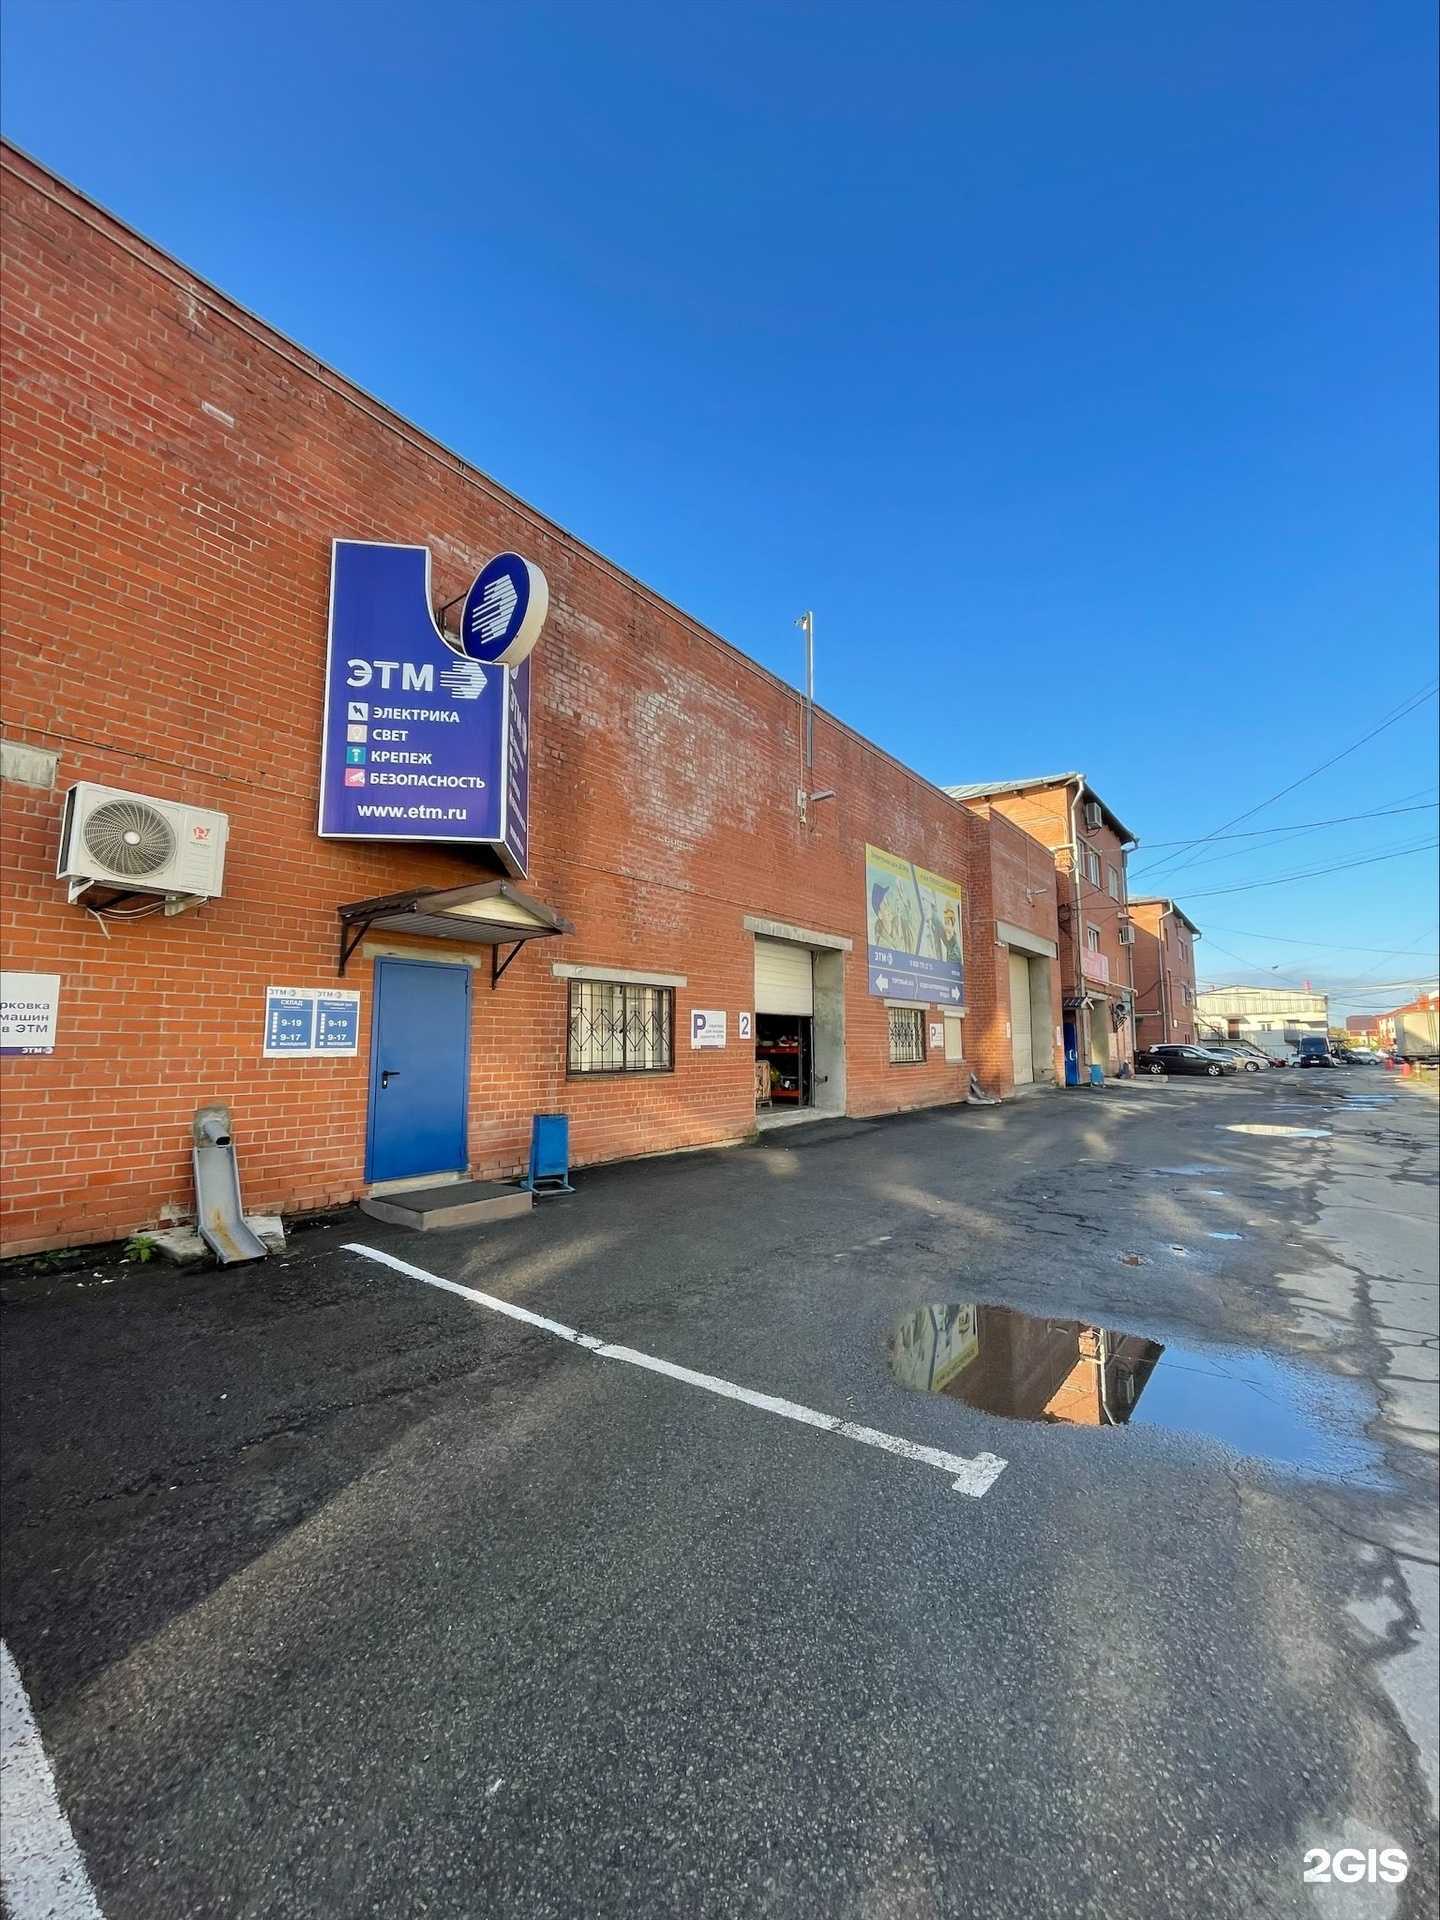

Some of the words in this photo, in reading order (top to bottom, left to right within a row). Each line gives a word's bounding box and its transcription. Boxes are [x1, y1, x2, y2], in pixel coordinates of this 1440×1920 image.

[346, 659, 434, 692] ЭТМ
[373, 707, 460, 723] ЭЛЕКТРИКА
[372, 729, 409, 742] СВЕТ
[370, 751, 433, 765] КРЕПЕЖ
[369, 773, 486, 789] БЕЗОПАСНОСТЬ
[357, 805, 467, 820] www.etm.ru
[16, 1024, 48, 1033] ЭТМ
[281, 1019, 302, 1027] 9-19
[742, 1016, 749, 1035] 2
